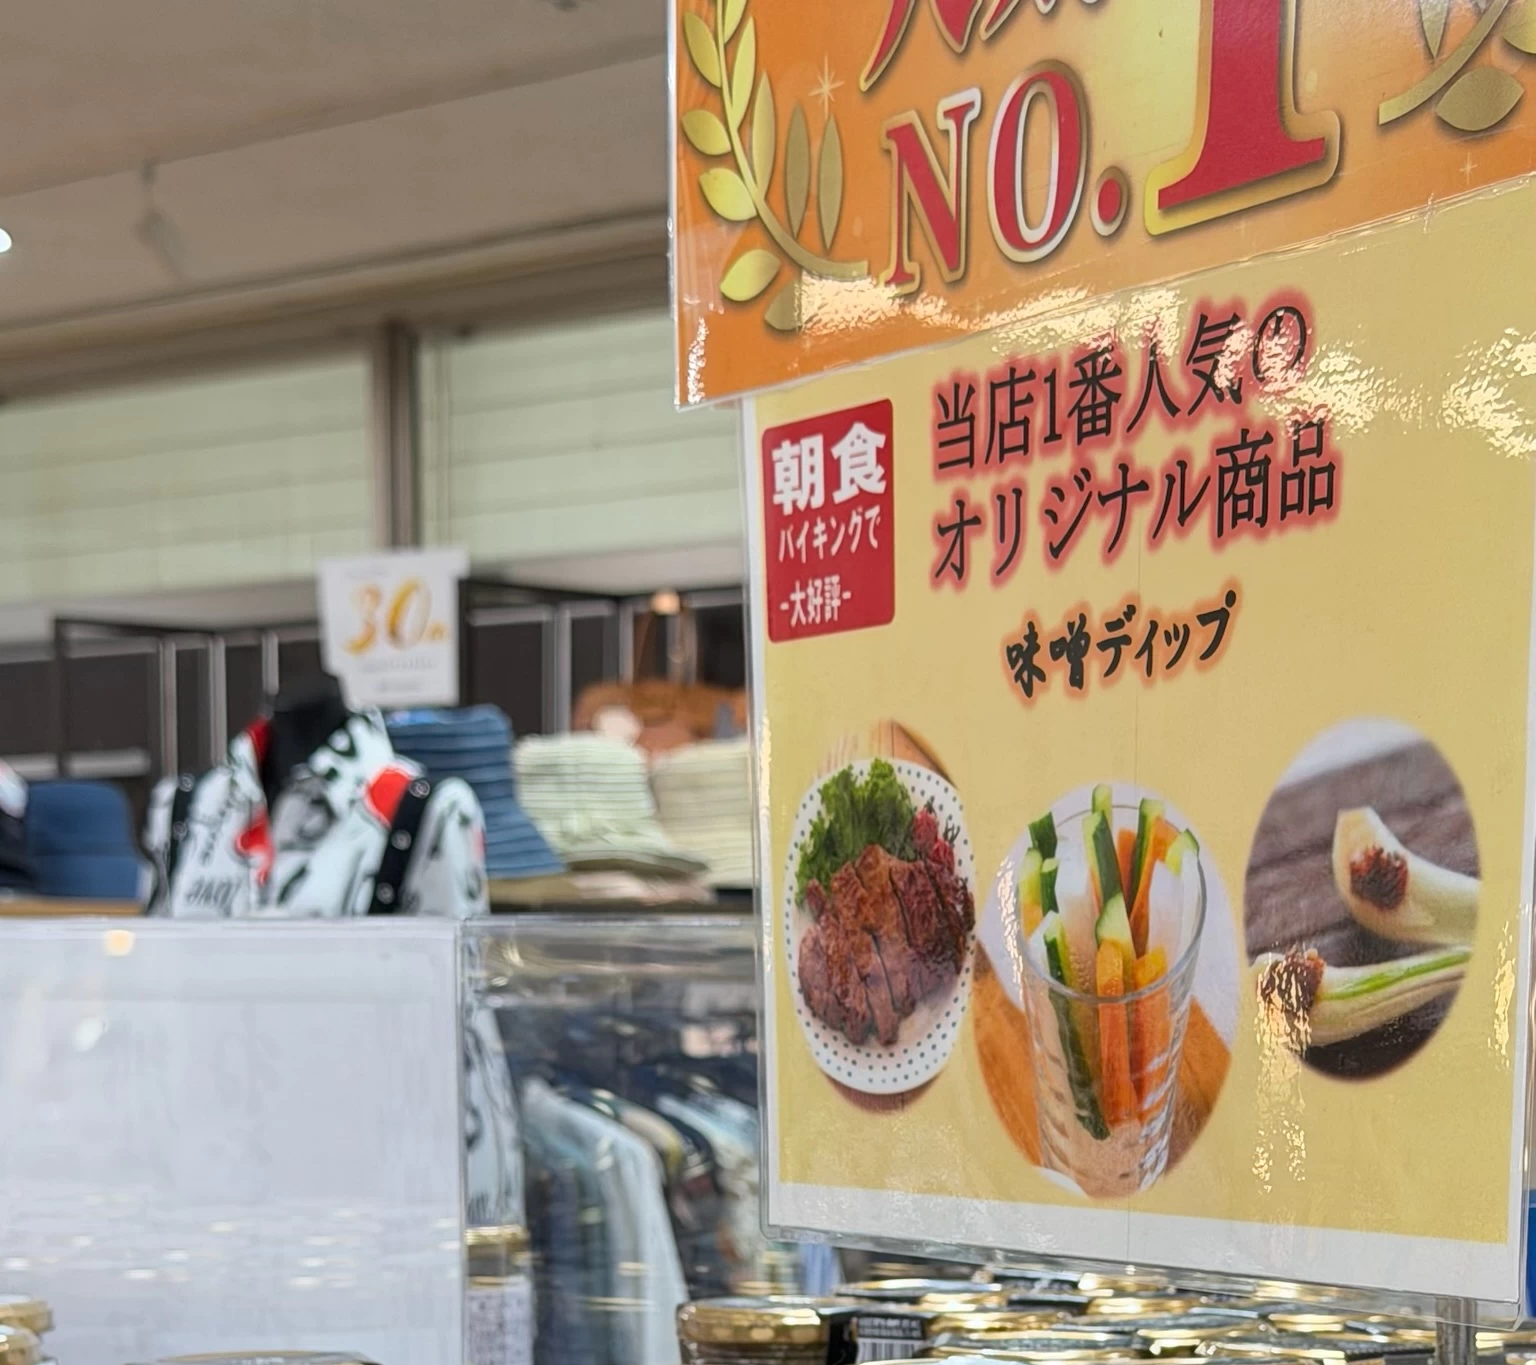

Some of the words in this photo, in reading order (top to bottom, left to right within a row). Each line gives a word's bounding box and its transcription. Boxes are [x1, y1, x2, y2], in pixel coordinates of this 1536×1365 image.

[936, 305, 1308, 470] 当店1番人気の
[771, 421, 887, 516] 朝食
[935, 419, 1337, 582] オリジナル商品
[778, 504, 881, 564] バイキングで
[1006, 590, 1237, 699] 味噌ディップ
